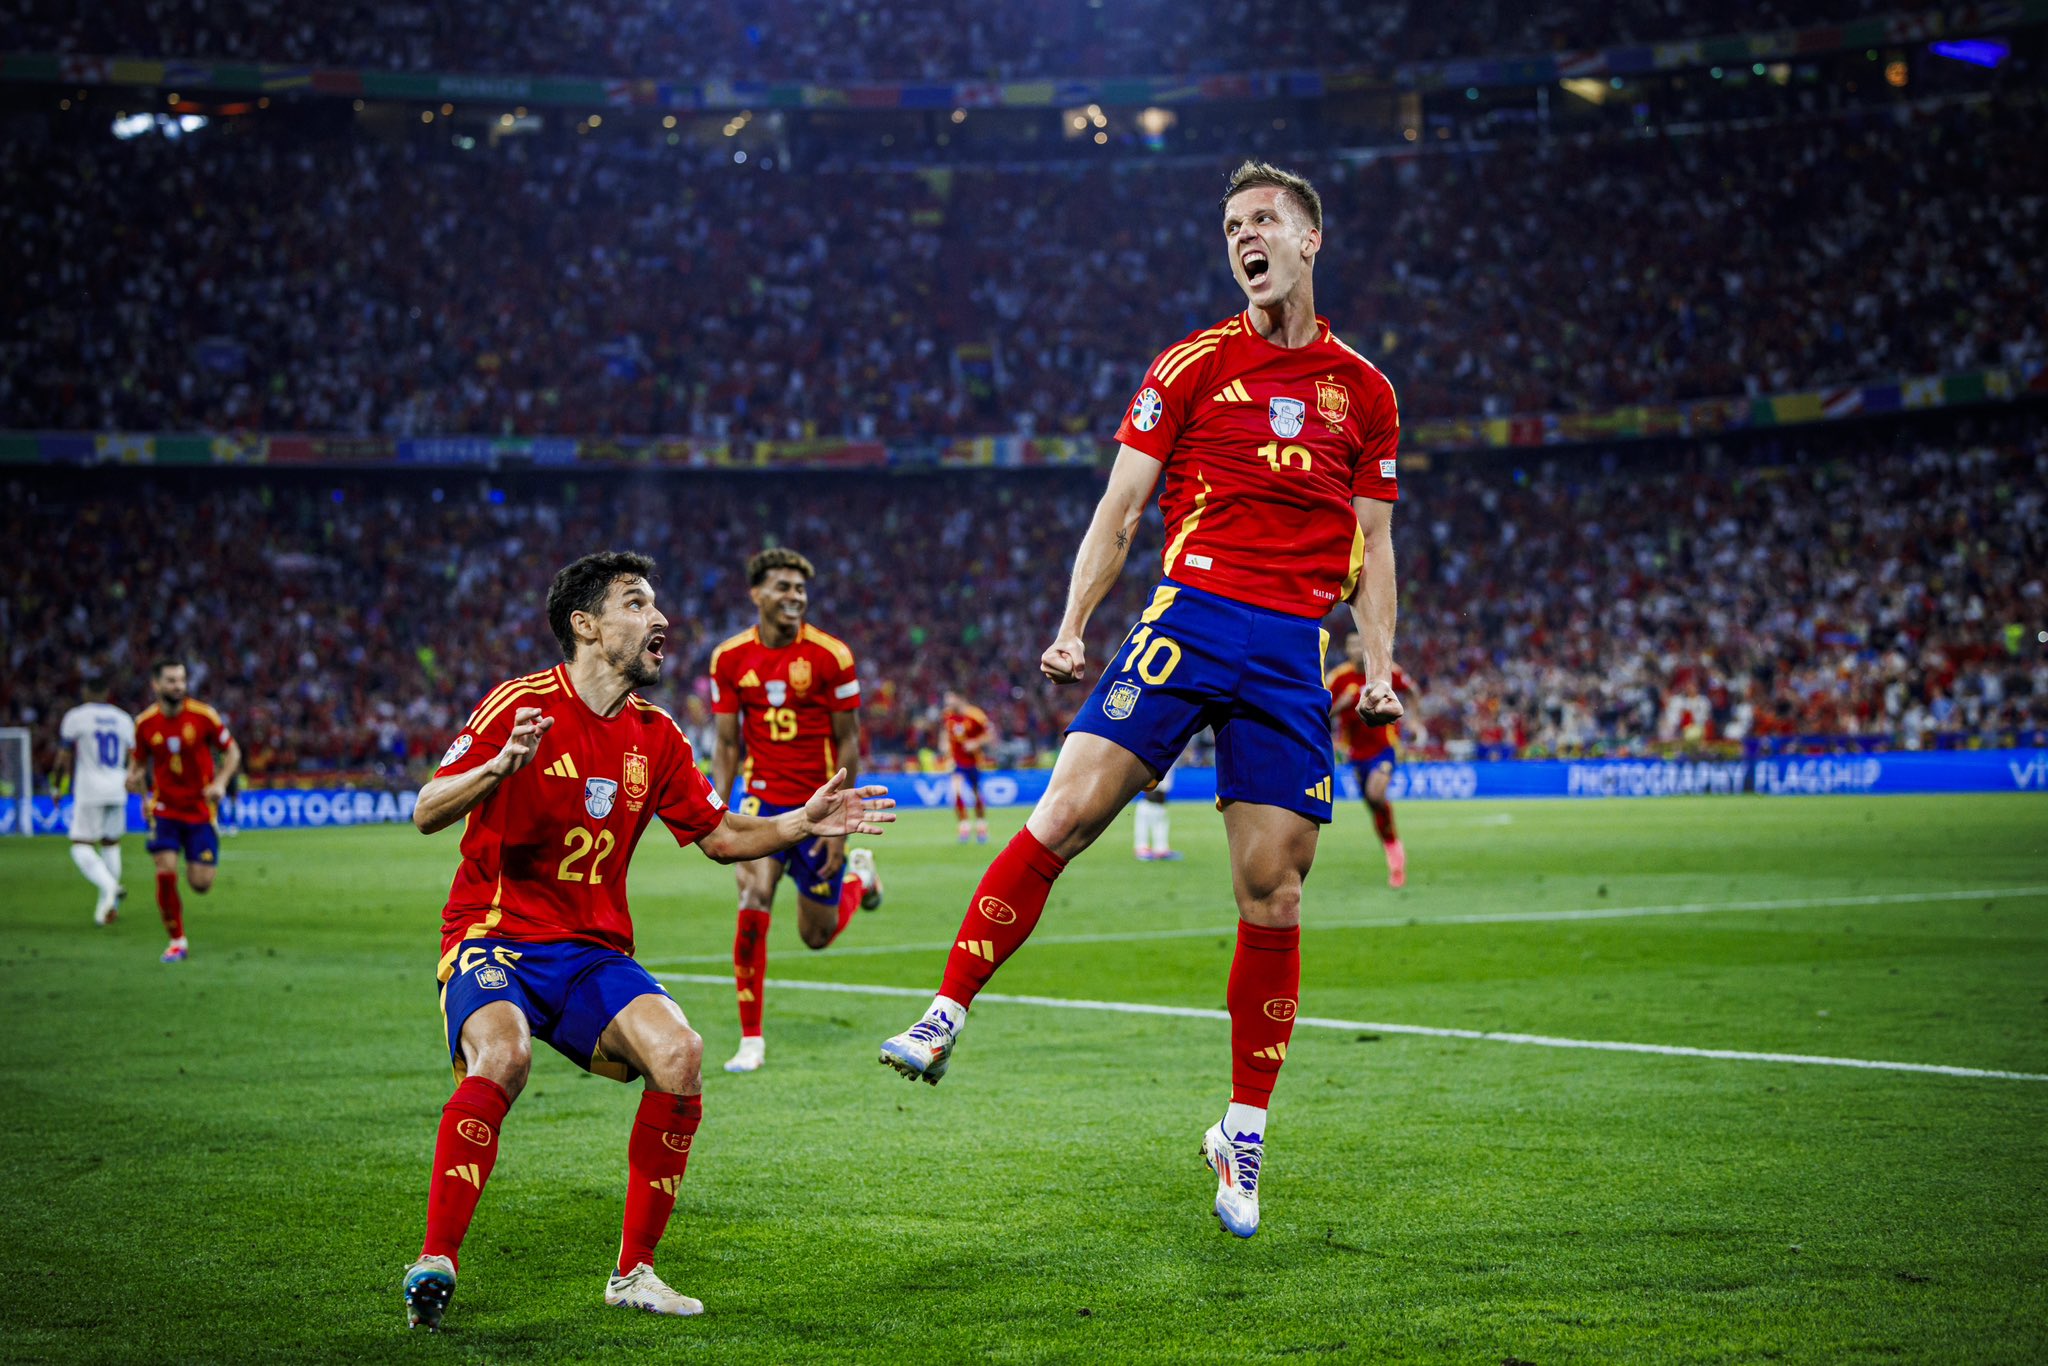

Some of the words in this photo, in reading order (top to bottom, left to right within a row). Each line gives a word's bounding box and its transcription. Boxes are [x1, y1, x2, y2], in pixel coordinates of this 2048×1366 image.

[1258, 441, 1312, 472] 10
[1121, 626, 1182, 685] 10
[763, 707, 798, 741] 19
[94, 730, 119, 768] 10
[557, 826, 616, 884] 22
